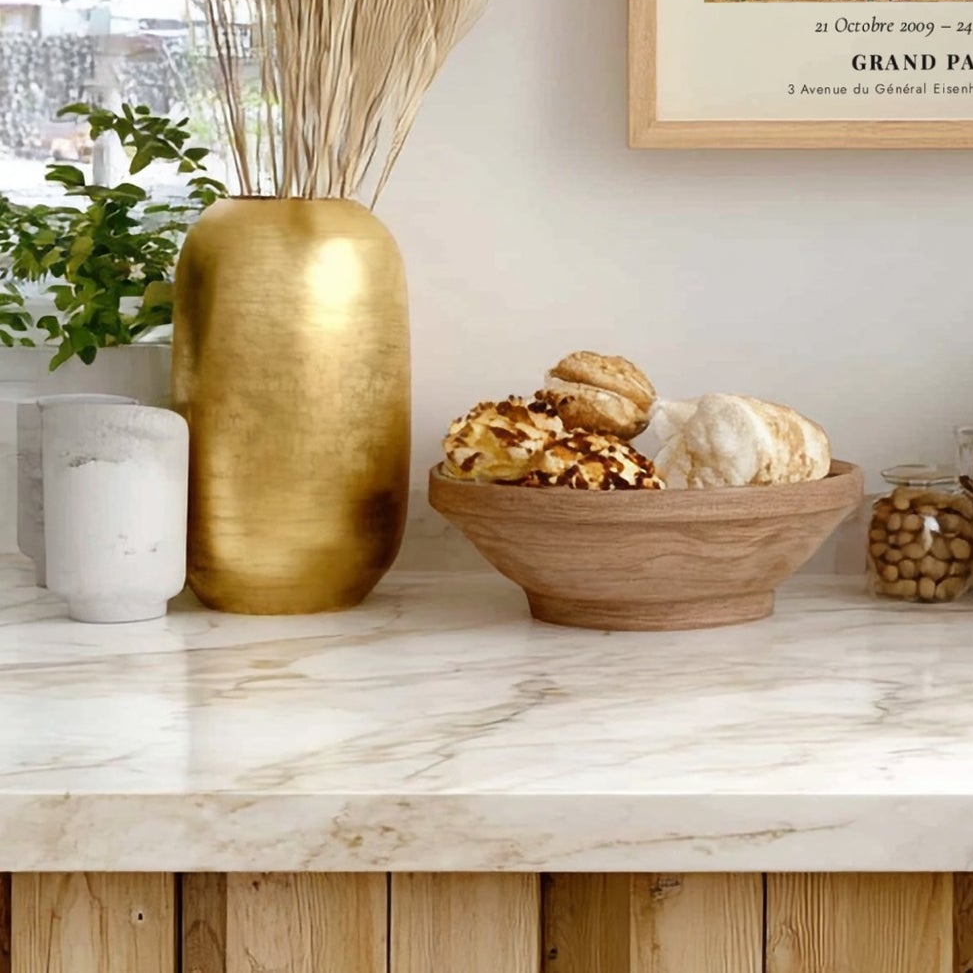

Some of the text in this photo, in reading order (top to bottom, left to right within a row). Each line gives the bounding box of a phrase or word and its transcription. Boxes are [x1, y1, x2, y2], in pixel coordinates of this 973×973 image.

[814, 22, 828, 33] 21
[834, 16, 894, 33] Octobre
[899, 21, 935, 37] 2009
[956, 21, 973, 35] 24
[851, 53, 937, 71] GRAND
[787, 83, 796, 95] 3
[800, 83, 848, 95] Avenue
[852, 82, 869, 95] du
[874, 82, 927, 95] Général
